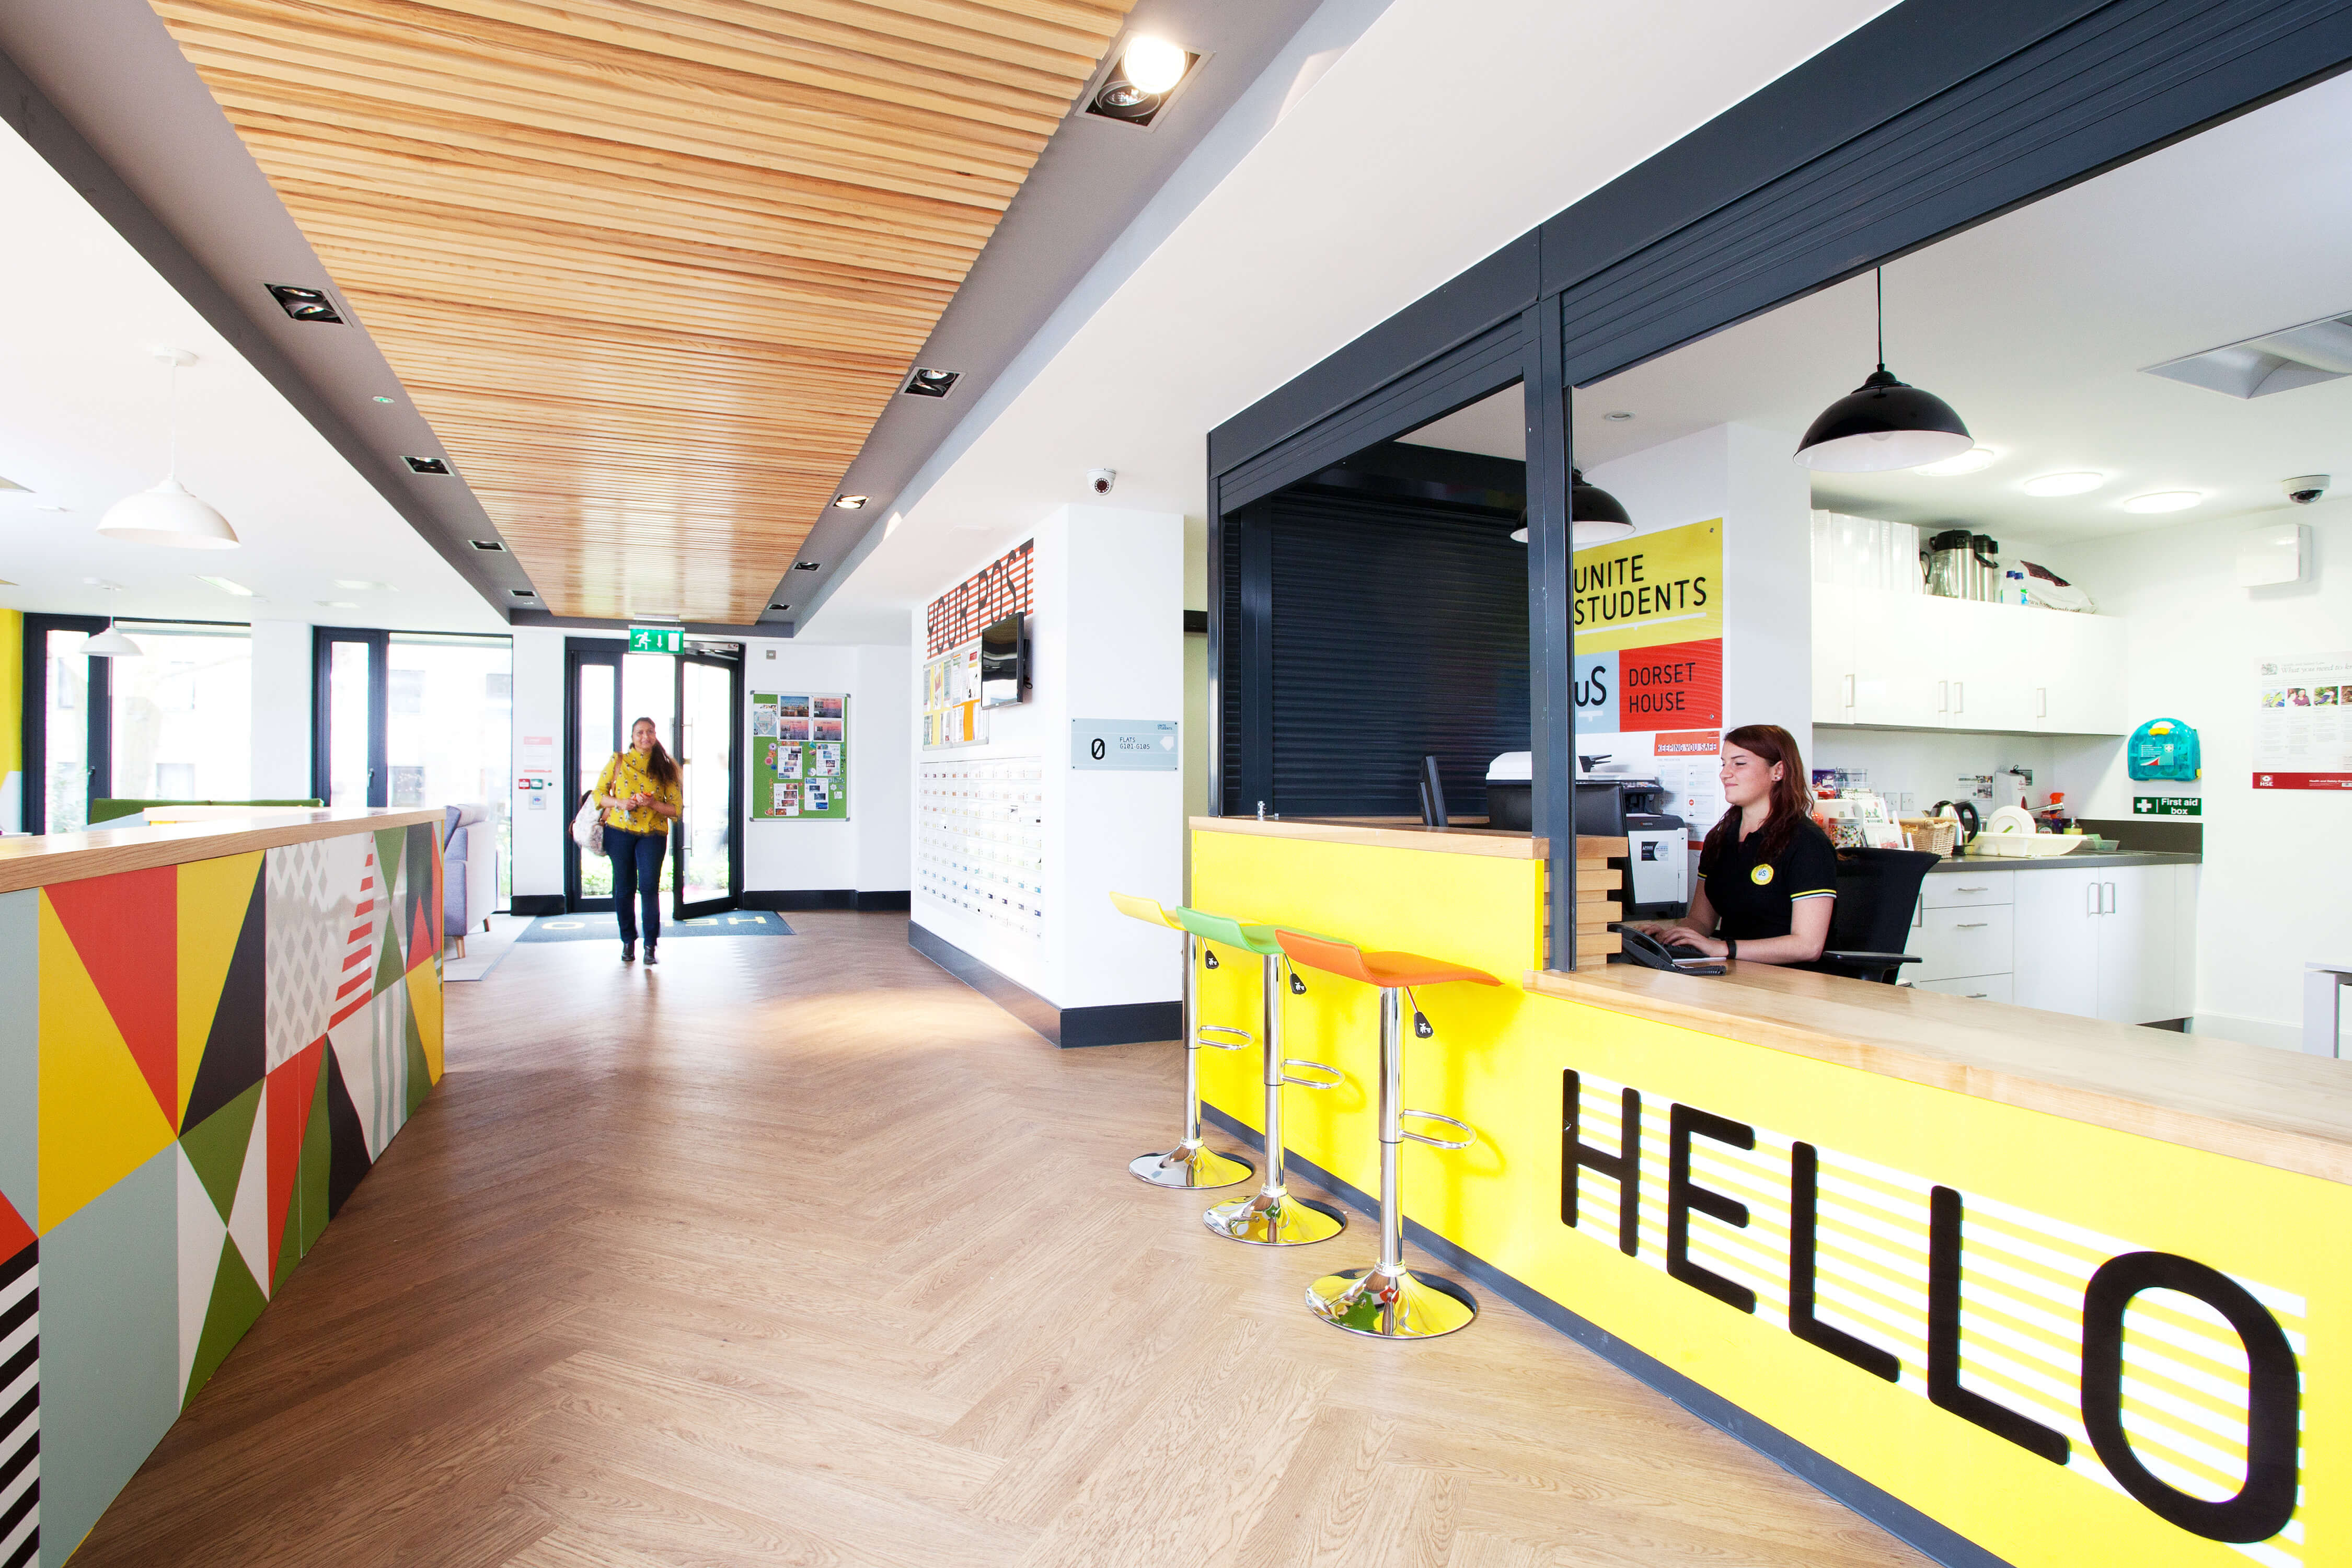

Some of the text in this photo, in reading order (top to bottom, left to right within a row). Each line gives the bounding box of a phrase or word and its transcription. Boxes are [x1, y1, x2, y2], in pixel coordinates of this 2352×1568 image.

[1574, 554, 1644, 593] UNITE
[928, 538, 1034, 657] YOUR POST
[1574, 577, 1707, 625] STUDENTS
[1629, 662, 1696, 687] DORSET
[1629, 691, 1686, 713] HOUSE
[1560, 1068, 2300, 1544] HELLO
